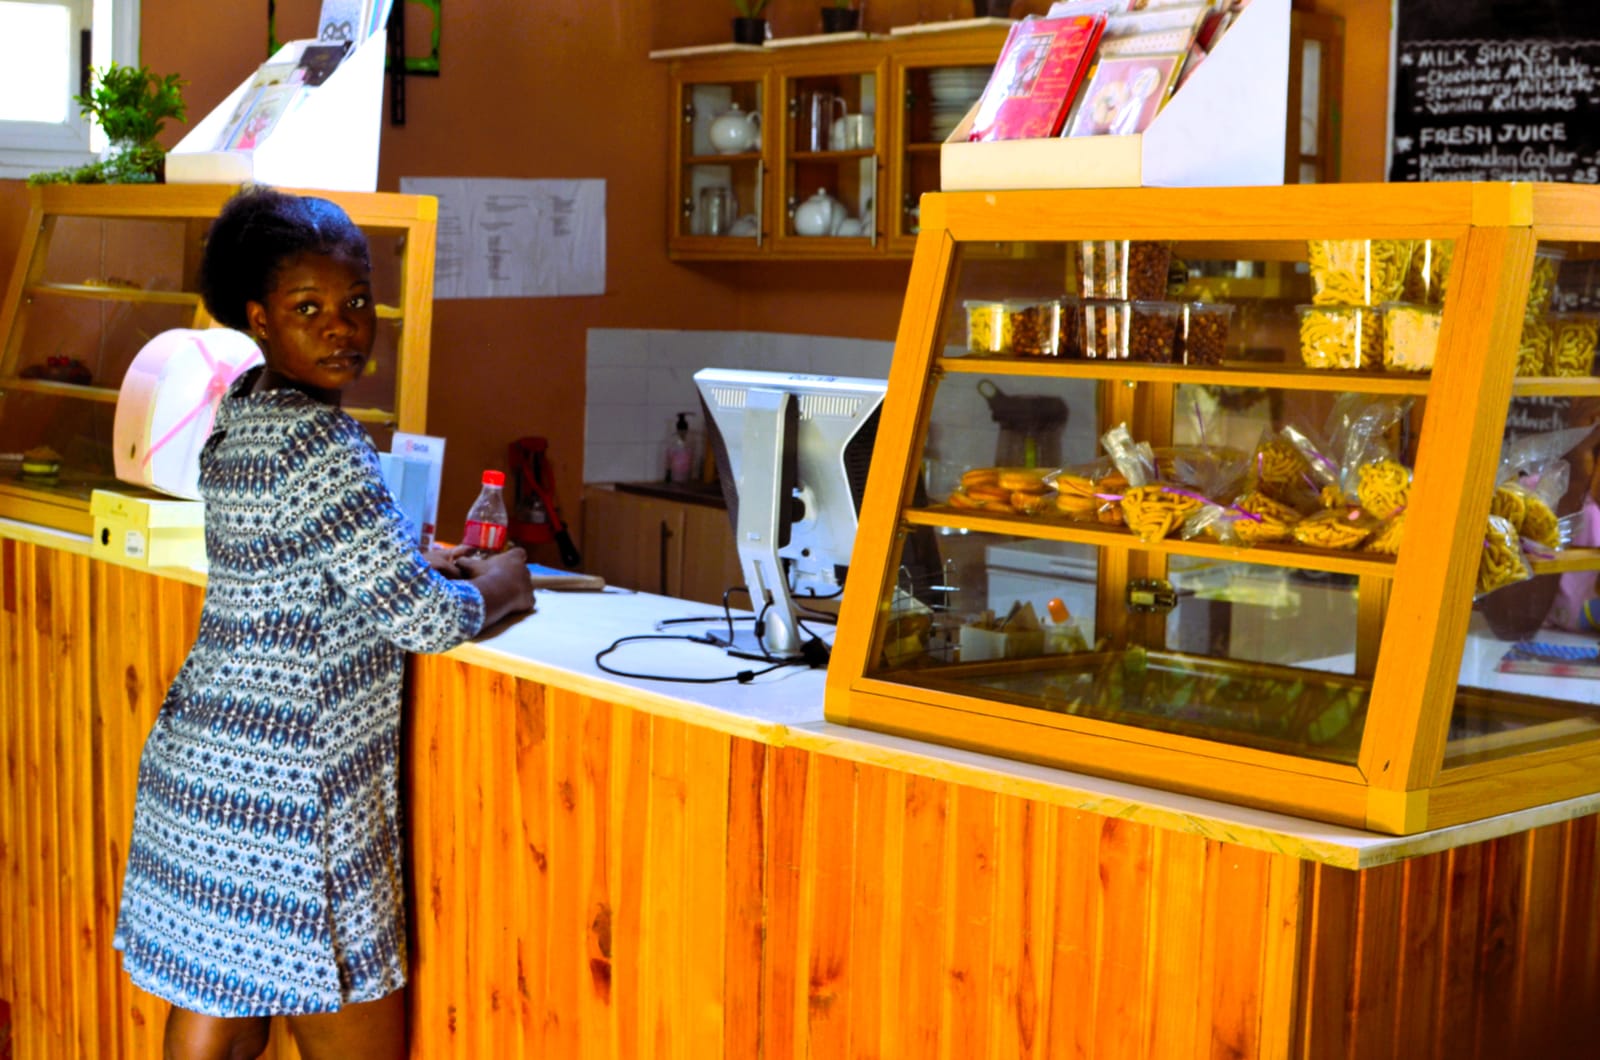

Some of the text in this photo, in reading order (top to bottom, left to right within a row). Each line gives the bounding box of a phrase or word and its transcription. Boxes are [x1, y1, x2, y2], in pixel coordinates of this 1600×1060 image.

[1418, 44, 1552, 67] MILK SHAKES
[1420, 122, 1567, 148] FRESH JUICE
